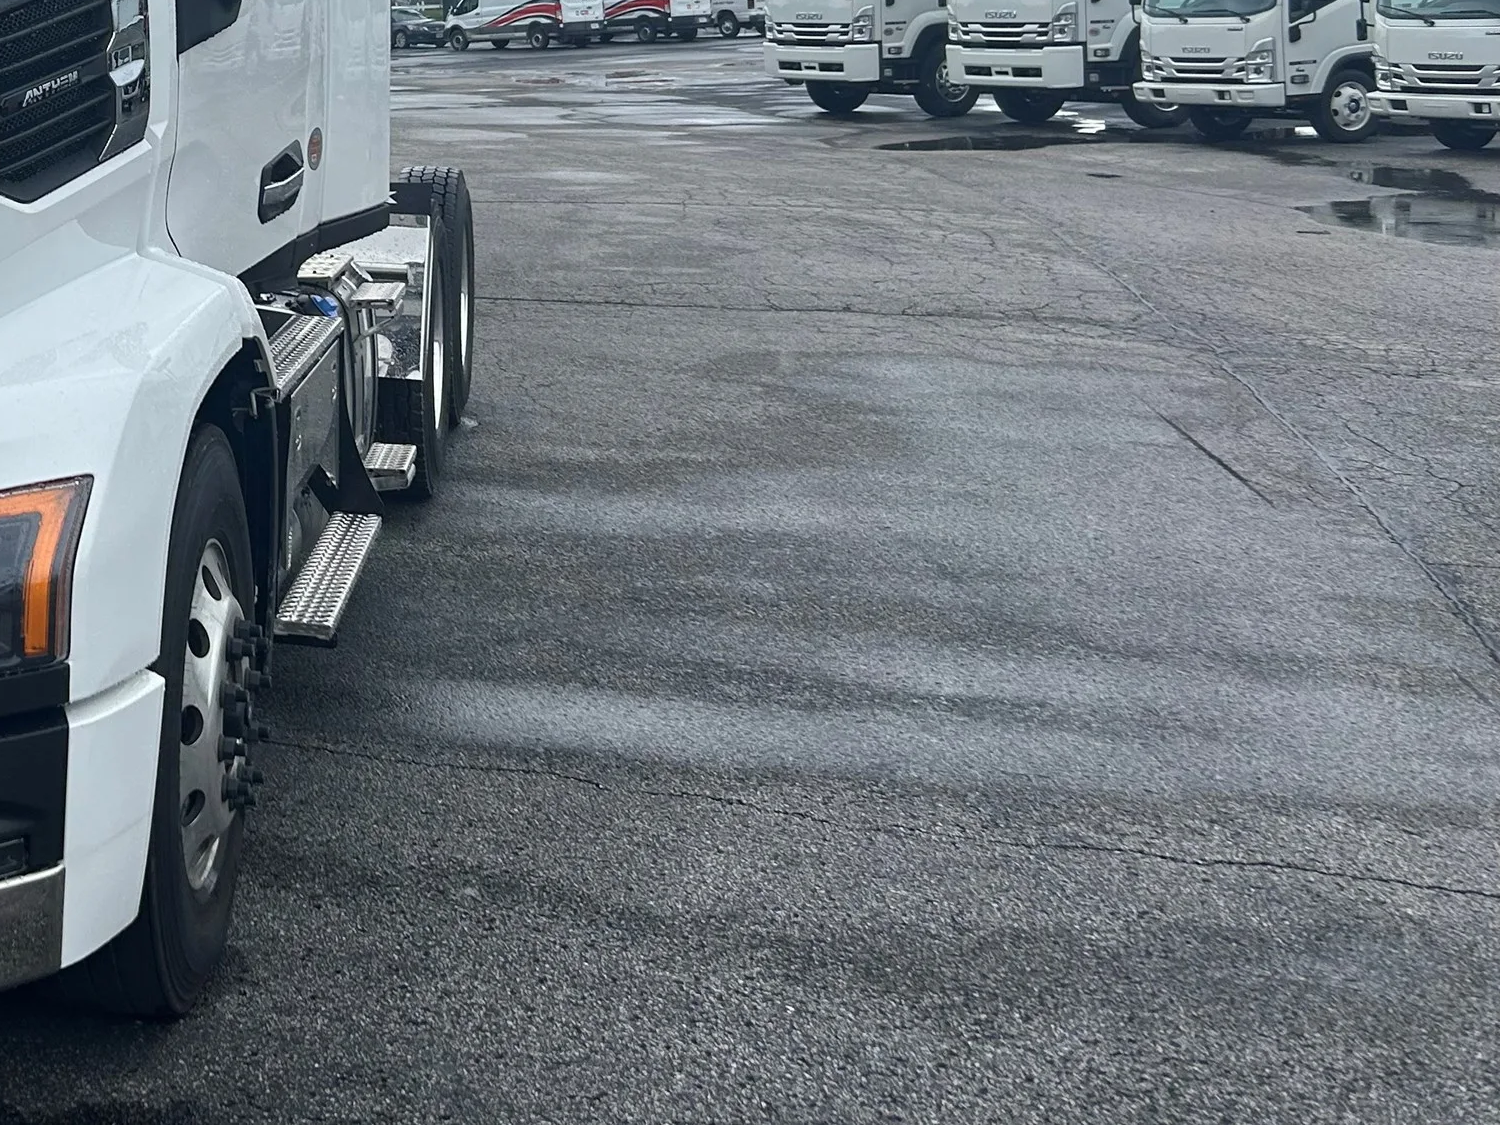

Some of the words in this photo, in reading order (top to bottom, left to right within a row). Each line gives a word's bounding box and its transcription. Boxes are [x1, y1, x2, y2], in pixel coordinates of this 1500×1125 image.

[795, 12, 823, 20] ISUZU
[985, 10, 1017, 19] ISUZU
[1427, 52, 1464, 60] ISUZU
